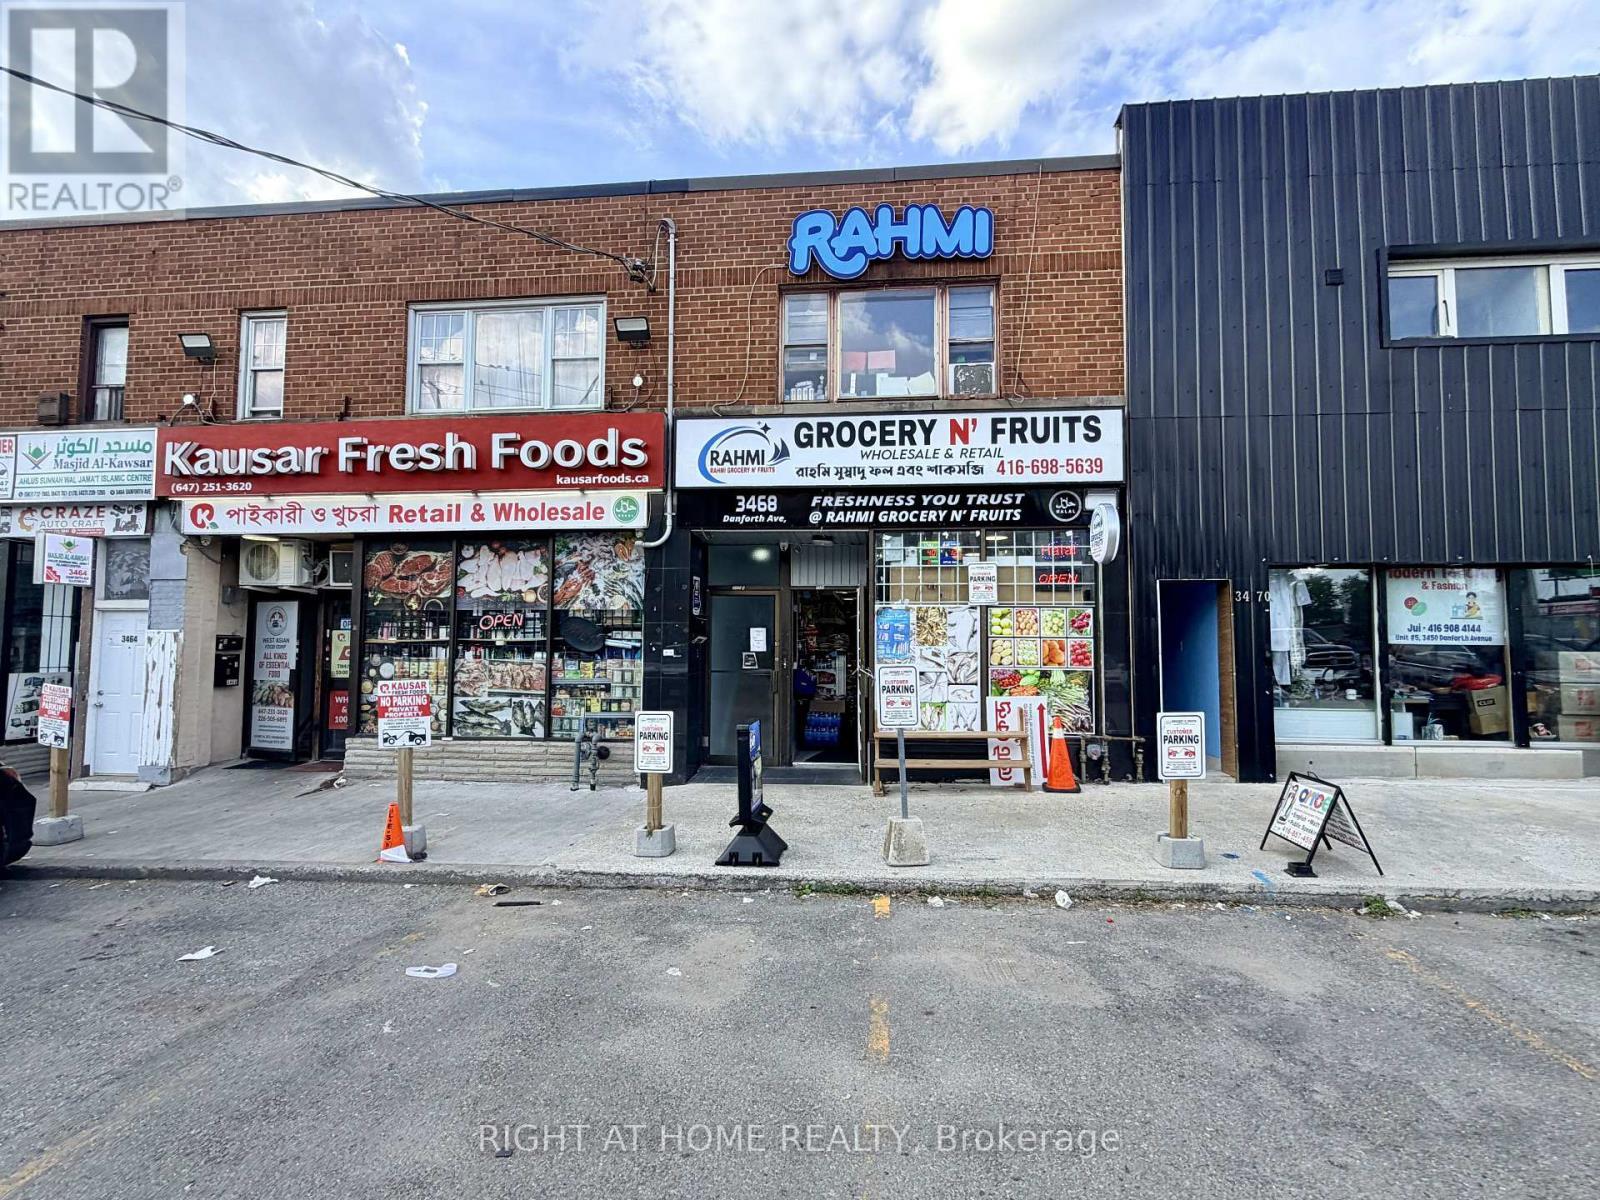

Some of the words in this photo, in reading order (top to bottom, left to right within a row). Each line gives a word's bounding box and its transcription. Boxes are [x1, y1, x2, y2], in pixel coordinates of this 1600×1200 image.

[787, 203, 994, 279] RAHMI
[794, 419, 937, 448] GROCERY
[950, 418, 977, 446] N'
[991, 415, 1101, 444] FRUITS
[54, 436, 99, 458] الكوثر
[103, 440, 153, 458] مسجد
[164, 441, 328, 476] Kausar
[338, 432, 476, 473] Fresh
[492, 427, 648, 470] Foods
[710, 449, 765, 466] RAHMI
[860, 449, 940, 461] WHOLESALE
[944, 449, 954, 459] &
[960, 448, 1004, 459] RETAIL
[53, 459, 89, 472] Masjid
[91, 457, 152, 470] Al-Kawsar
[795, 463, 830, 478] রাহমি
[869, 466, 893, 477] ফল
[897, 465, 923, 477] এবং
[996, 457, 1103, 476] 416-698-5639
[101, 475, 125, 483] ISLAMIC
[126, 474, 151, 482] CENTRE
[556, 473, 649, 485] kausarfoods.ca
[171, 482, 200, 494] (647)
[202, 482, 252, 492] 251-3620
[735, 495, 778, 513] 3468
[811, 494, 916, 507] FRESHNESS
[921, 494, 960, 506] YOU
[966, 493, 1025, 505] TRUST
[40, 506, 106, 519] CRAZE
[225, 501, 305, 525] পাইকারী
[311, 505, 326, 523] ও
[332, 503, 380, 528] খুচরা
[389, 503, 461, 524] Retail
[470, 503, 486, 522] &
[493, 501, 605, 522] Wholesale
[722, 514, 764, 524] Danforth
[809, 511, 822, 524] @
[825, 511, 874, 523] RAHMI
[878, 510, 945, 523] GROCERY
[950, 510, 966, 521] N'
[970, 509, 1021, 521] FRUITS
[39, 520, 69, 528] AUTO
[72, 520, 104, 528] CRAFT
[1038, 573, 1079, 584] OPEN
[1421, 581, 1430, 590] &
[1431, 580, 1468, 590] Fashion
[479, 613, 524, 630] OPEN
[1428, 624, 1442, 633] 416
[1445, 624, 1460, 633] 908
[1462, 623, 1482, 633] 4144
[266, 661, 290, 669] ESSENTIAL
[391, 681, 427, 690] KAUSAR
[881, 684, 915, 694] PARKING
[380, 696, 391, 707] NO
[393, 695, 427, 706] PARKING
[639, 731, 668, 740] PARKING
[1163, 734, 1199, 744] PARKING
